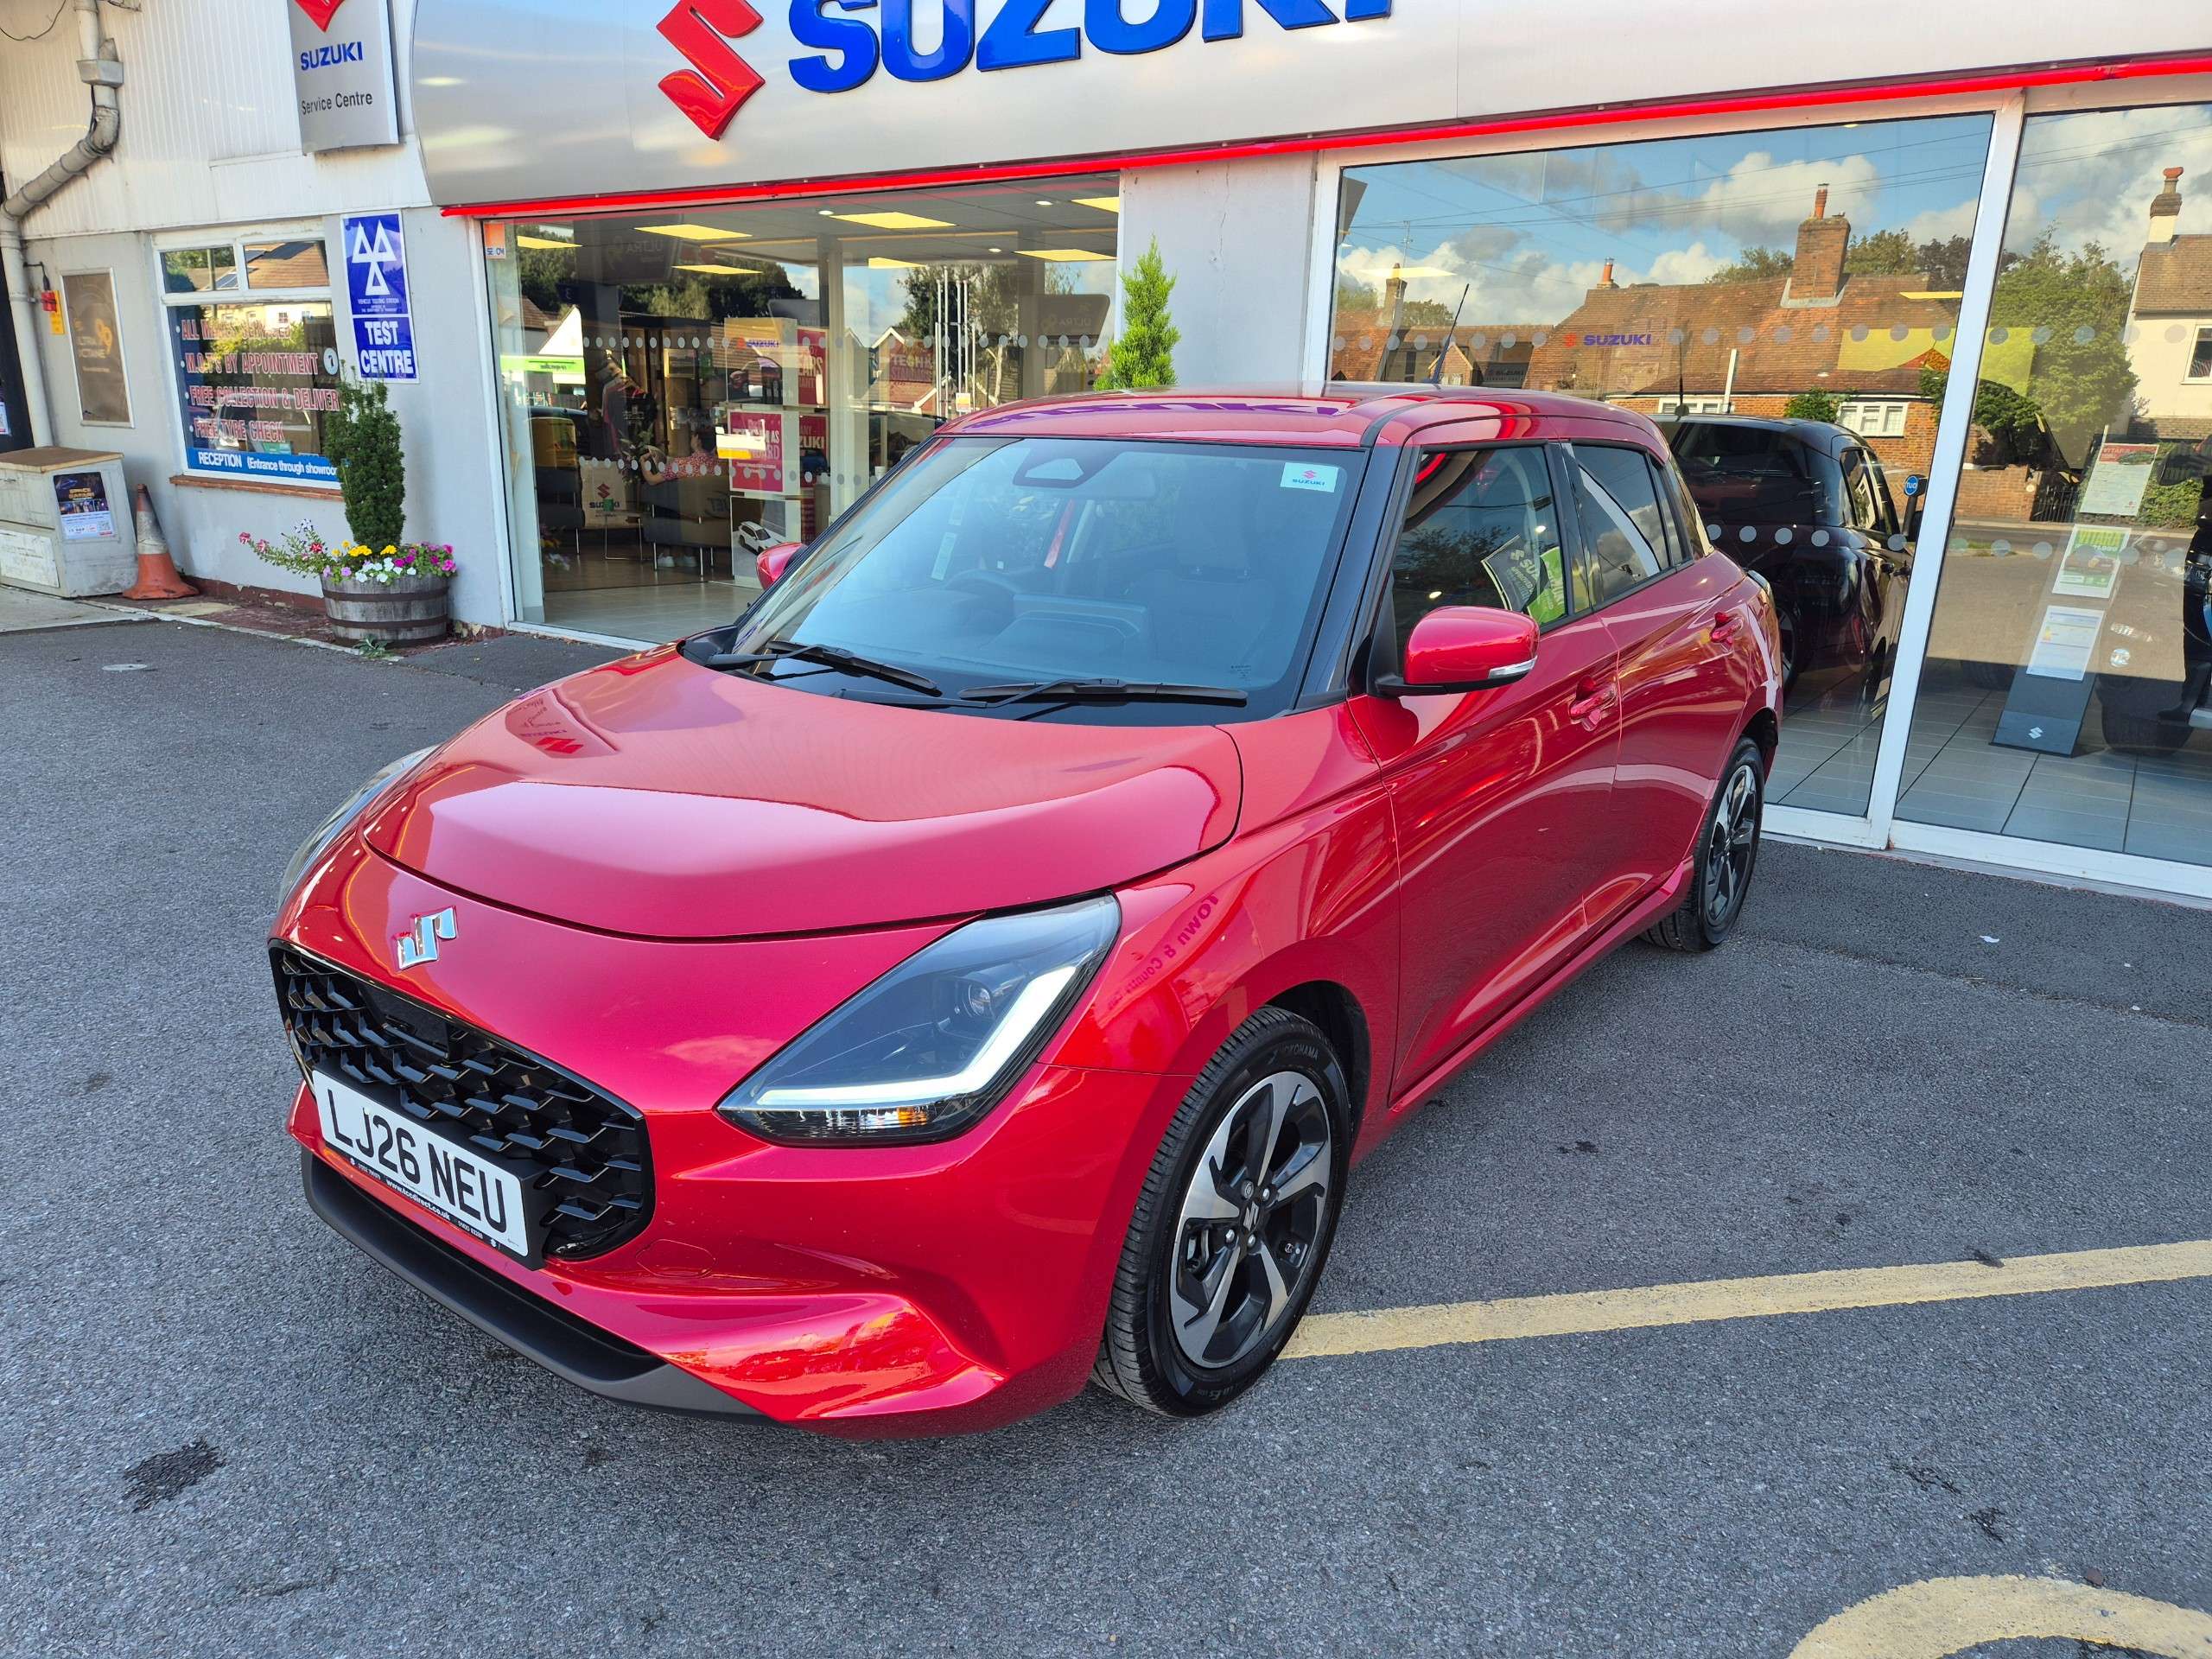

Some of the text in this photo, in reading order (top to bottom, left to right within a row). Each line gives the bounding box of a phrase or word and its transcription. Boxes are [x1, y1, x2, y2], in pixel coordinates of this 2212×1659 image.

[300, 41, 363, 71] SUZUKI
[789, 0, 1390, 93] SUZU
[302, 91, 372, 115] Service Centre
[181, 318, 200, 341] ALL
[365, 321, 398, 346] TEST
[1584, 334, 1651, 346] SUZUKI
[224, 353, 238, 374] BY
[241, 353, 319, 375] APPOINTMENT
[360, 349, 414, 374] CENTRE
[189, 385, 340, 411] FREE COLLECTION & DELIVER
[194, 417, 218, 439] FREE
[248, 420, 286, 442] CHECK
[799, 435, 825, 448] ZUKI
[198, 451, 242, 467] RECEPTION
[247, 455, 277, 472] (Entrance
[278, 460, 304, 475] through
[327, 1090, 506, 1232] LJ26 NEU
[386, 1179, 450, 1221] www.tccdirect.co.uk
